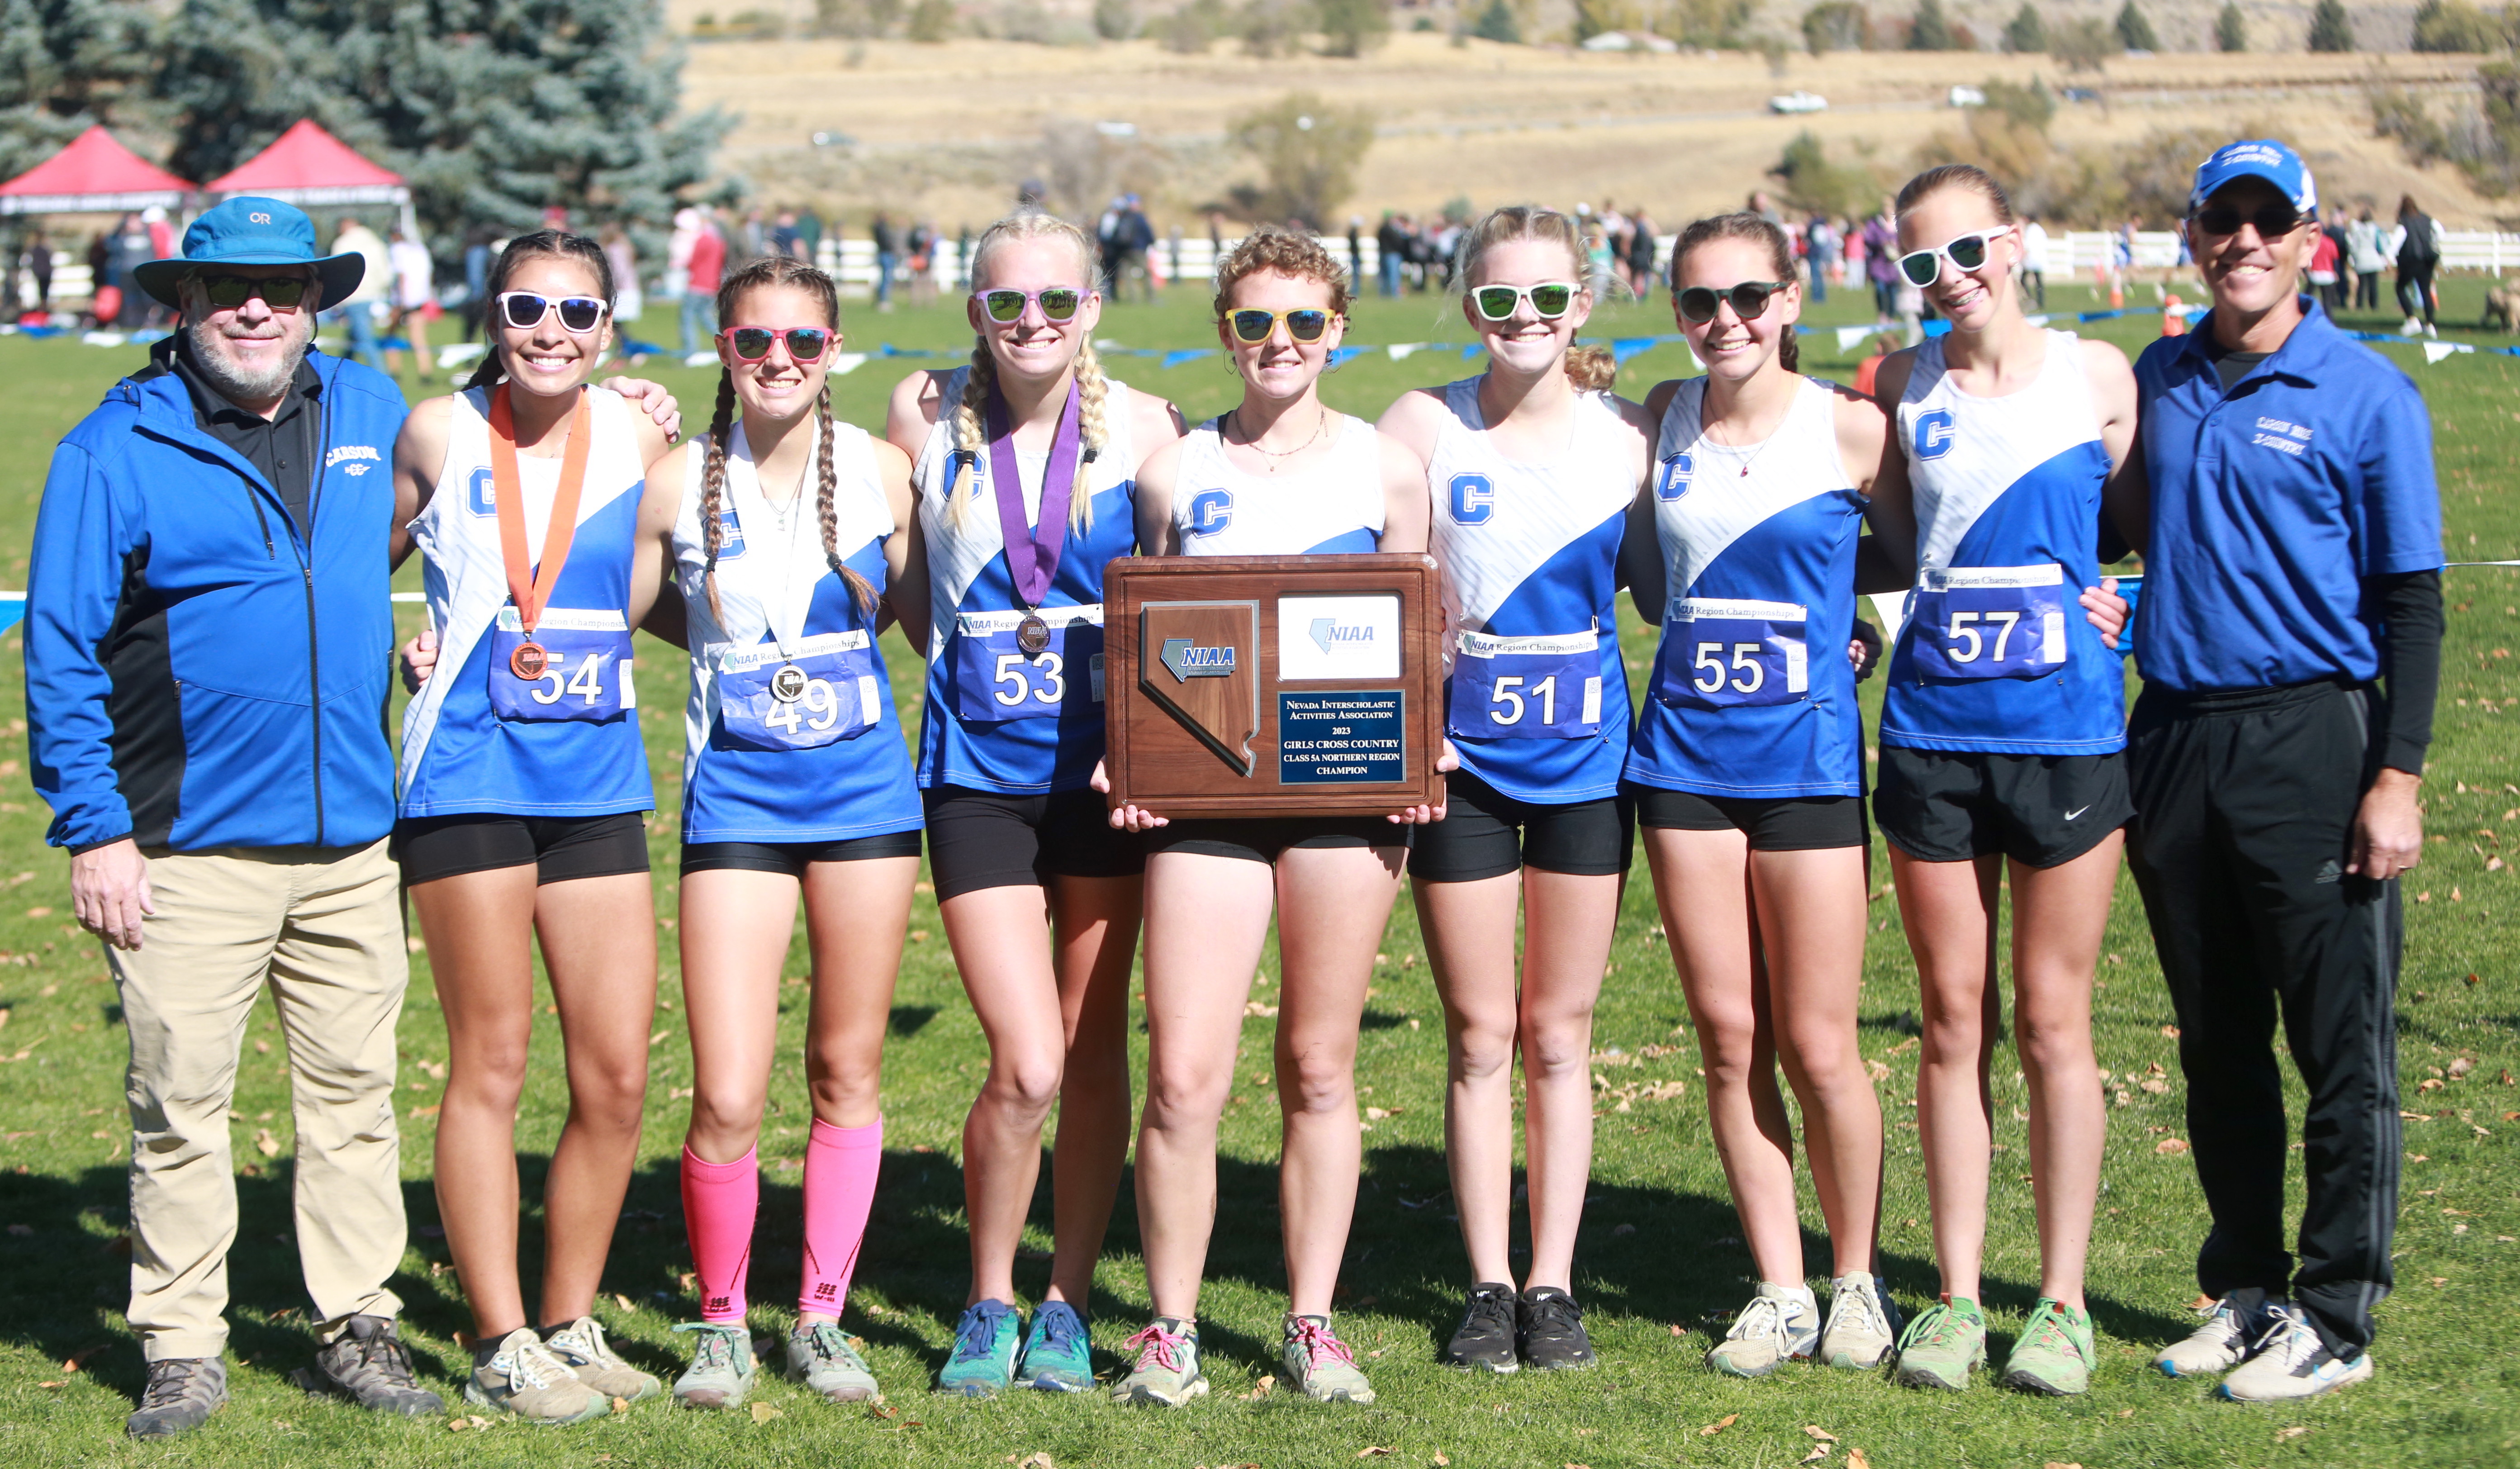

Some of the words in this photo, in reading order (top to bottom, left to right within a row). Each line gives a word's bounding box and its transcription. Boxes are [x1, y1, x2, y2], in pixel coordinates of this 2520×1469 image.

[250, 213, 271, 224] OR
[1913, 408, 1955, 461] C
[326, 446, 382, 467] CARSON
[940, 449, 986, 502] C
[466, 466, 497, 518] C
[1656, 452, 1696, 502] C
[1190, 488, 1233, 538] C
[1448, 472, 1494, 525] C
[1950, 576, 1979, 586] Region
[968, 620, 991, 629] NIAA
[994, 620, 1021, 629] Regio
[1046, 615, 1094, 627] mpionships
[1696, 607, 1724, 616] Region
[1726, 608, 1794, 617] Championships
[1328, 626, 1374, 641] NIAA
[1471, 640, 1494, 651] NIAA
[1497, 644, 1527, 652] Region
[1530, 641, 1593, 652] Championships
[1948, 611, 2020, 663] 57
[733, 654, 759, 666] NIAA
[794, 640, 859, 655] Championships
[1182, 647, 1234, 666] NIAA
[1694, 642, 1764, 694] 55
[531, 653, 603, 706] 54
[994, 652, 1066, 706] 53
[765, 677, 839, 735] 49
[1286, 701, 1319, 709] NEVADA
[1322, 700, 1395, 708] INTERSCHOLASTIC
[1290, 711, 1335, 719] ACTIVITIES
[1338, 711, 1393, 719] ASSOCIATION
[1490, 675, 1556, 725] 51
[1316, 740, 1348, 748] CROSS
[1351, 740, 1399, 748] COUNTRY
